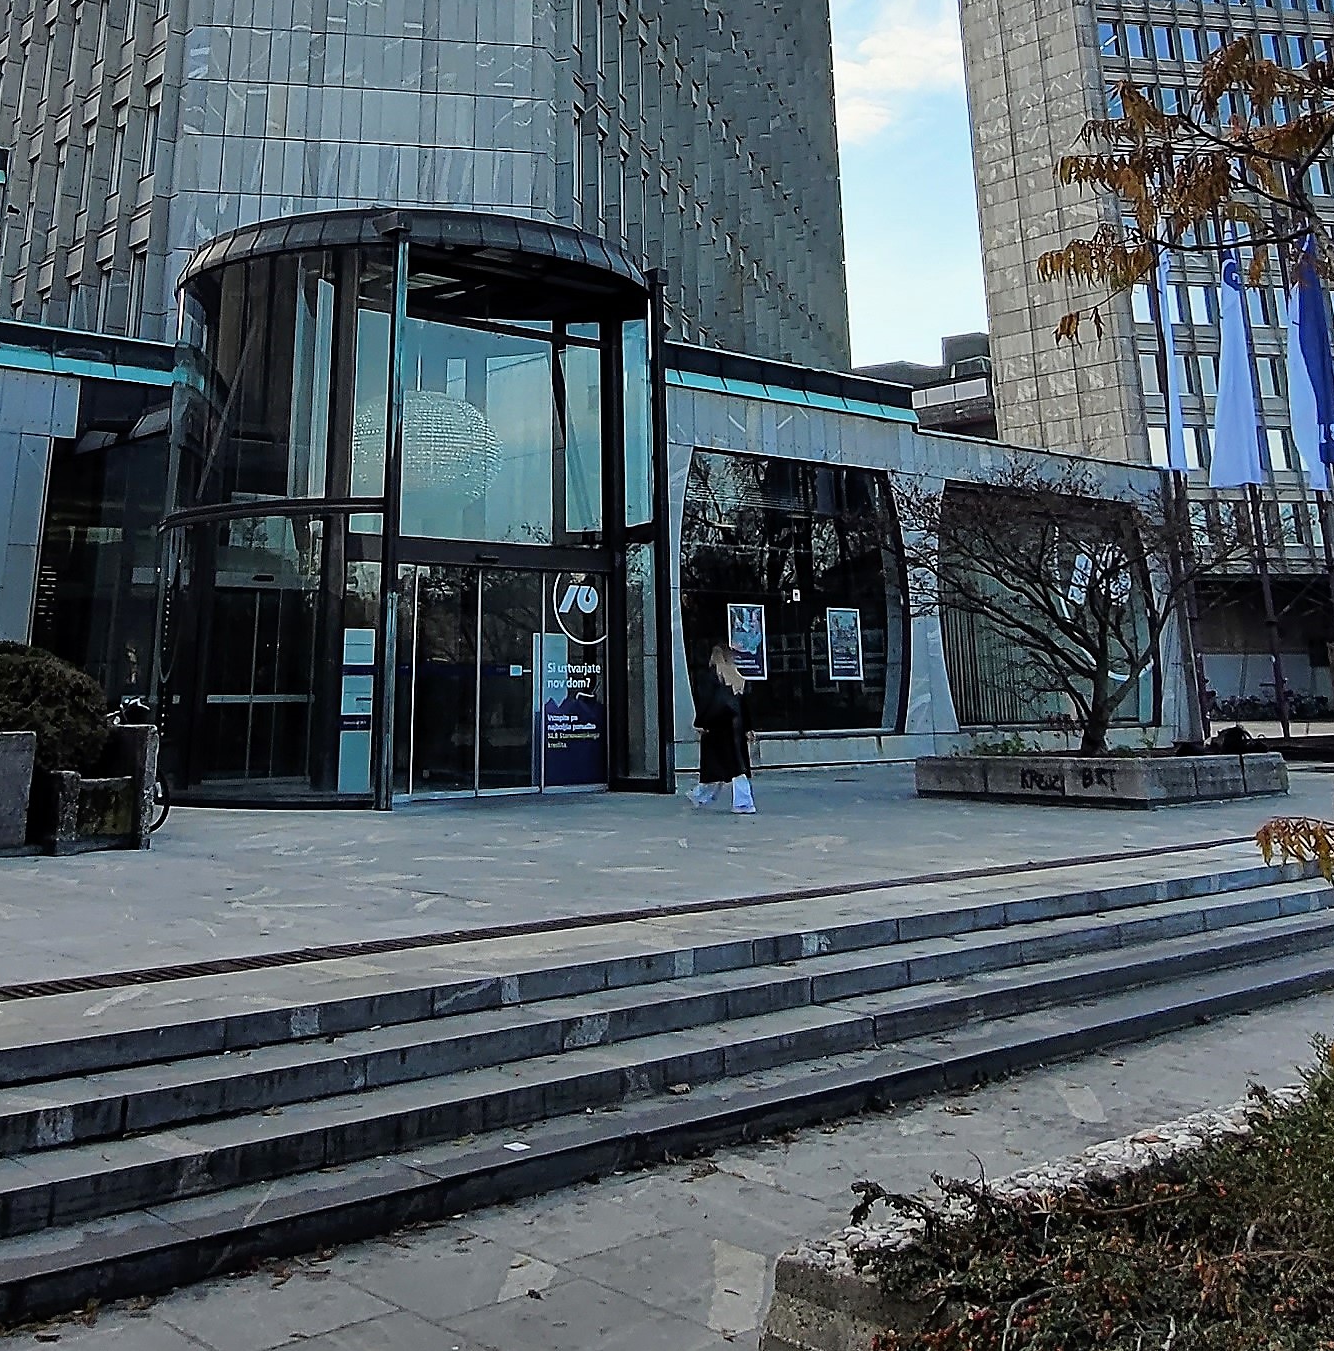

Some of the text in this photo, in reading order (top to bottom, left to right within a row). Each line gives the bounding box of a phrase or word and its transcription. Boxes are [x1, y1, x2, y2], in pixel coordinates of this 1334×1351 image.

[547, 663, 601, 676] Si ustvarjate
[547, 677, 591, 689] nov dom?
